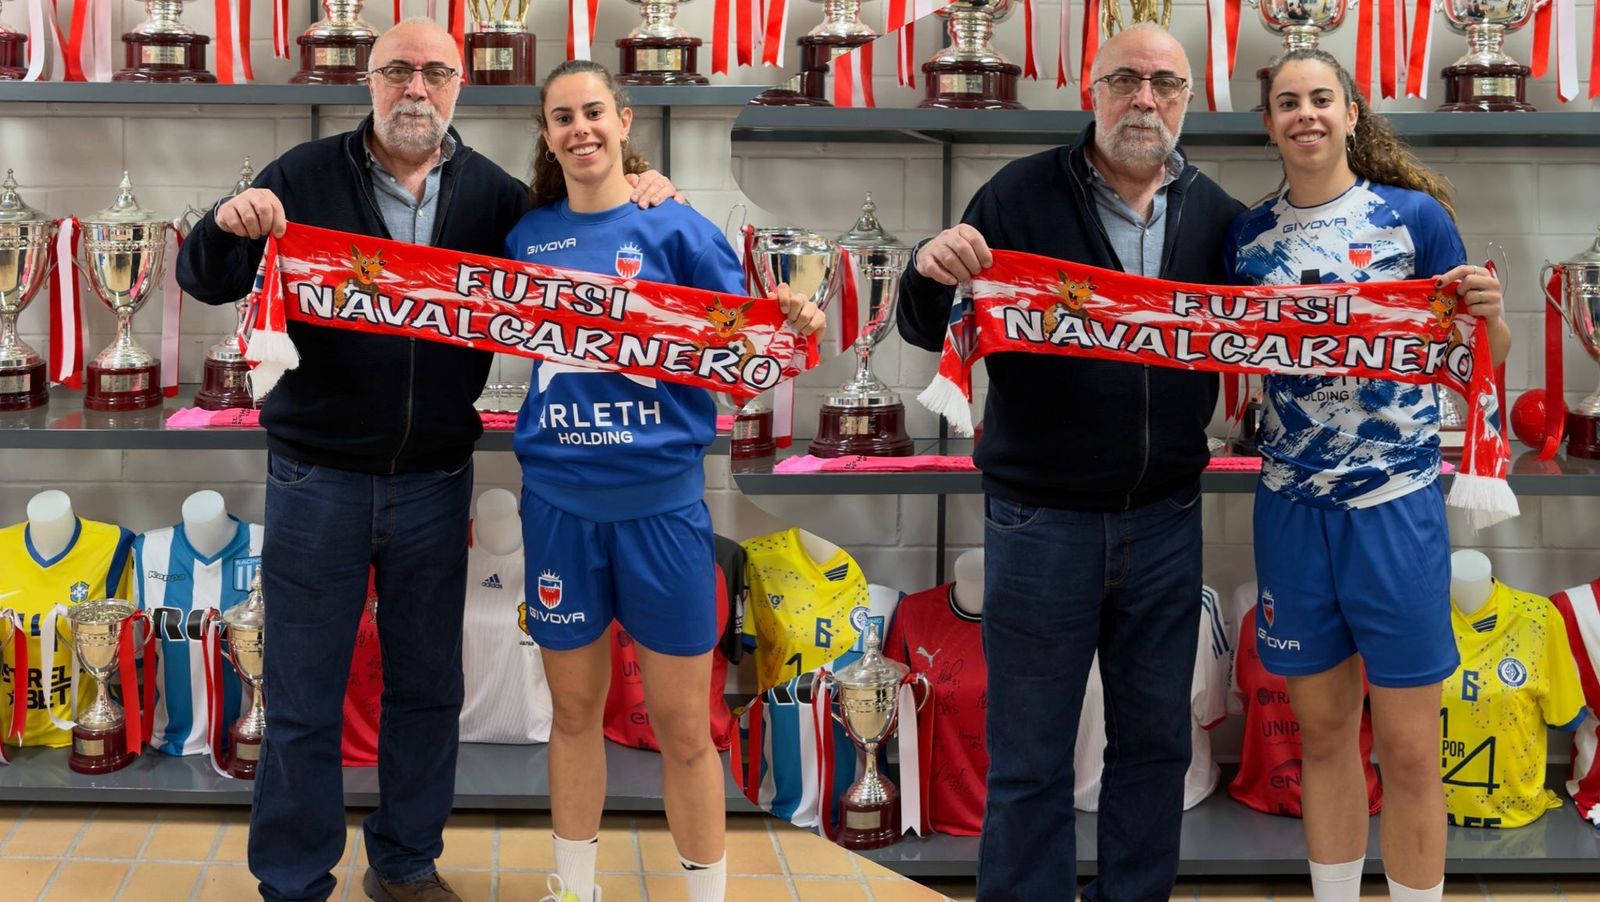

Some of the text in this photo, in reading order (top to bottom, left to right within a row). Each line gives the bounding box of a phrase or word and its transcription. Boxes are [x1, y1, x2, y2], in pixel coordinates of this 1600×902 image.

[1283, 217, 1347, 233] GIVOVA
[527, 238, 576, 254] GIVOVA
[456, 262, 630, 321] FUTSI
[1172, 291, 1353, 326] FUTSI
[297, 283, 782, 390] NAVALCARNERO
[558, 431, 634, 445] HOLDING
[148, 571, 186, 582] Kappa
[529, 606, 585, 624] GIVOVA
[815, 617, 831, 648] 6
[1462, 670, 1479, 702] 6
[1442, 740, 1465, 758] POR
[1442, 736, 1500, 796] 4
